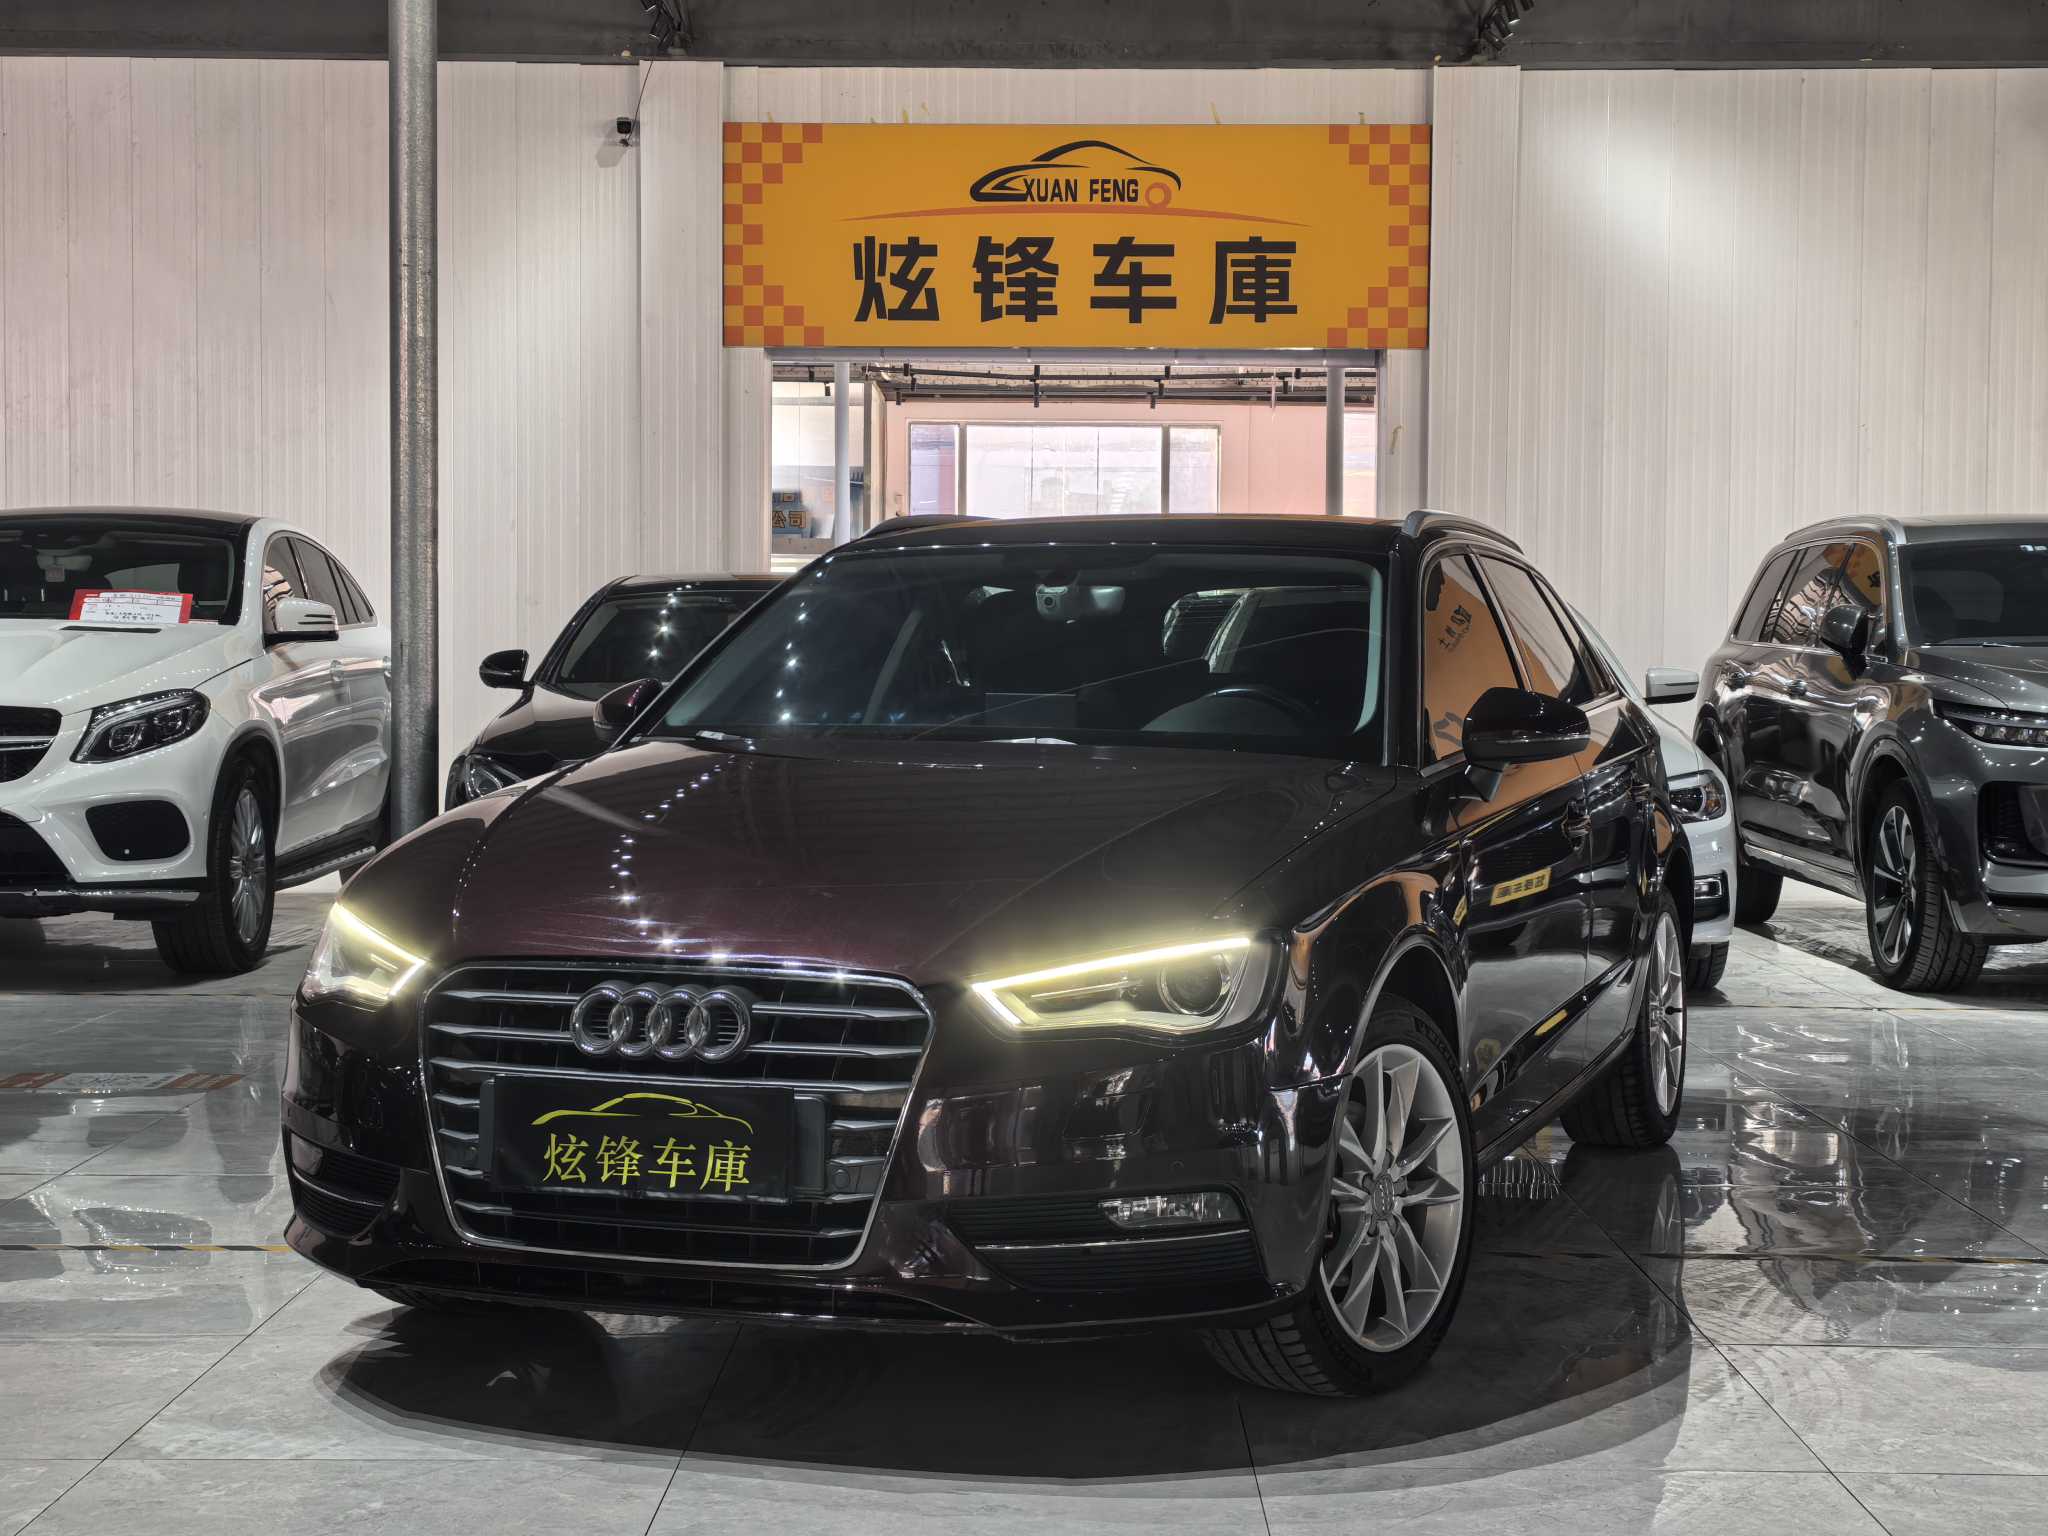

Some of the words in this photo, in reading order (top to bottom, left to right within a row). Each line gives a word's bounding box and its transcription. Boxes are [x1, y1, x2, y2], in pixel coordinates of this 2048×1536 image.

[1022, 178, 1077, 203] XUAN
[1090, 178, 1138, 203] FENG
[853, 236, 1298, 324] 炫锋车庫
[543, 1133, 752, 1192] 炫锋车庫
